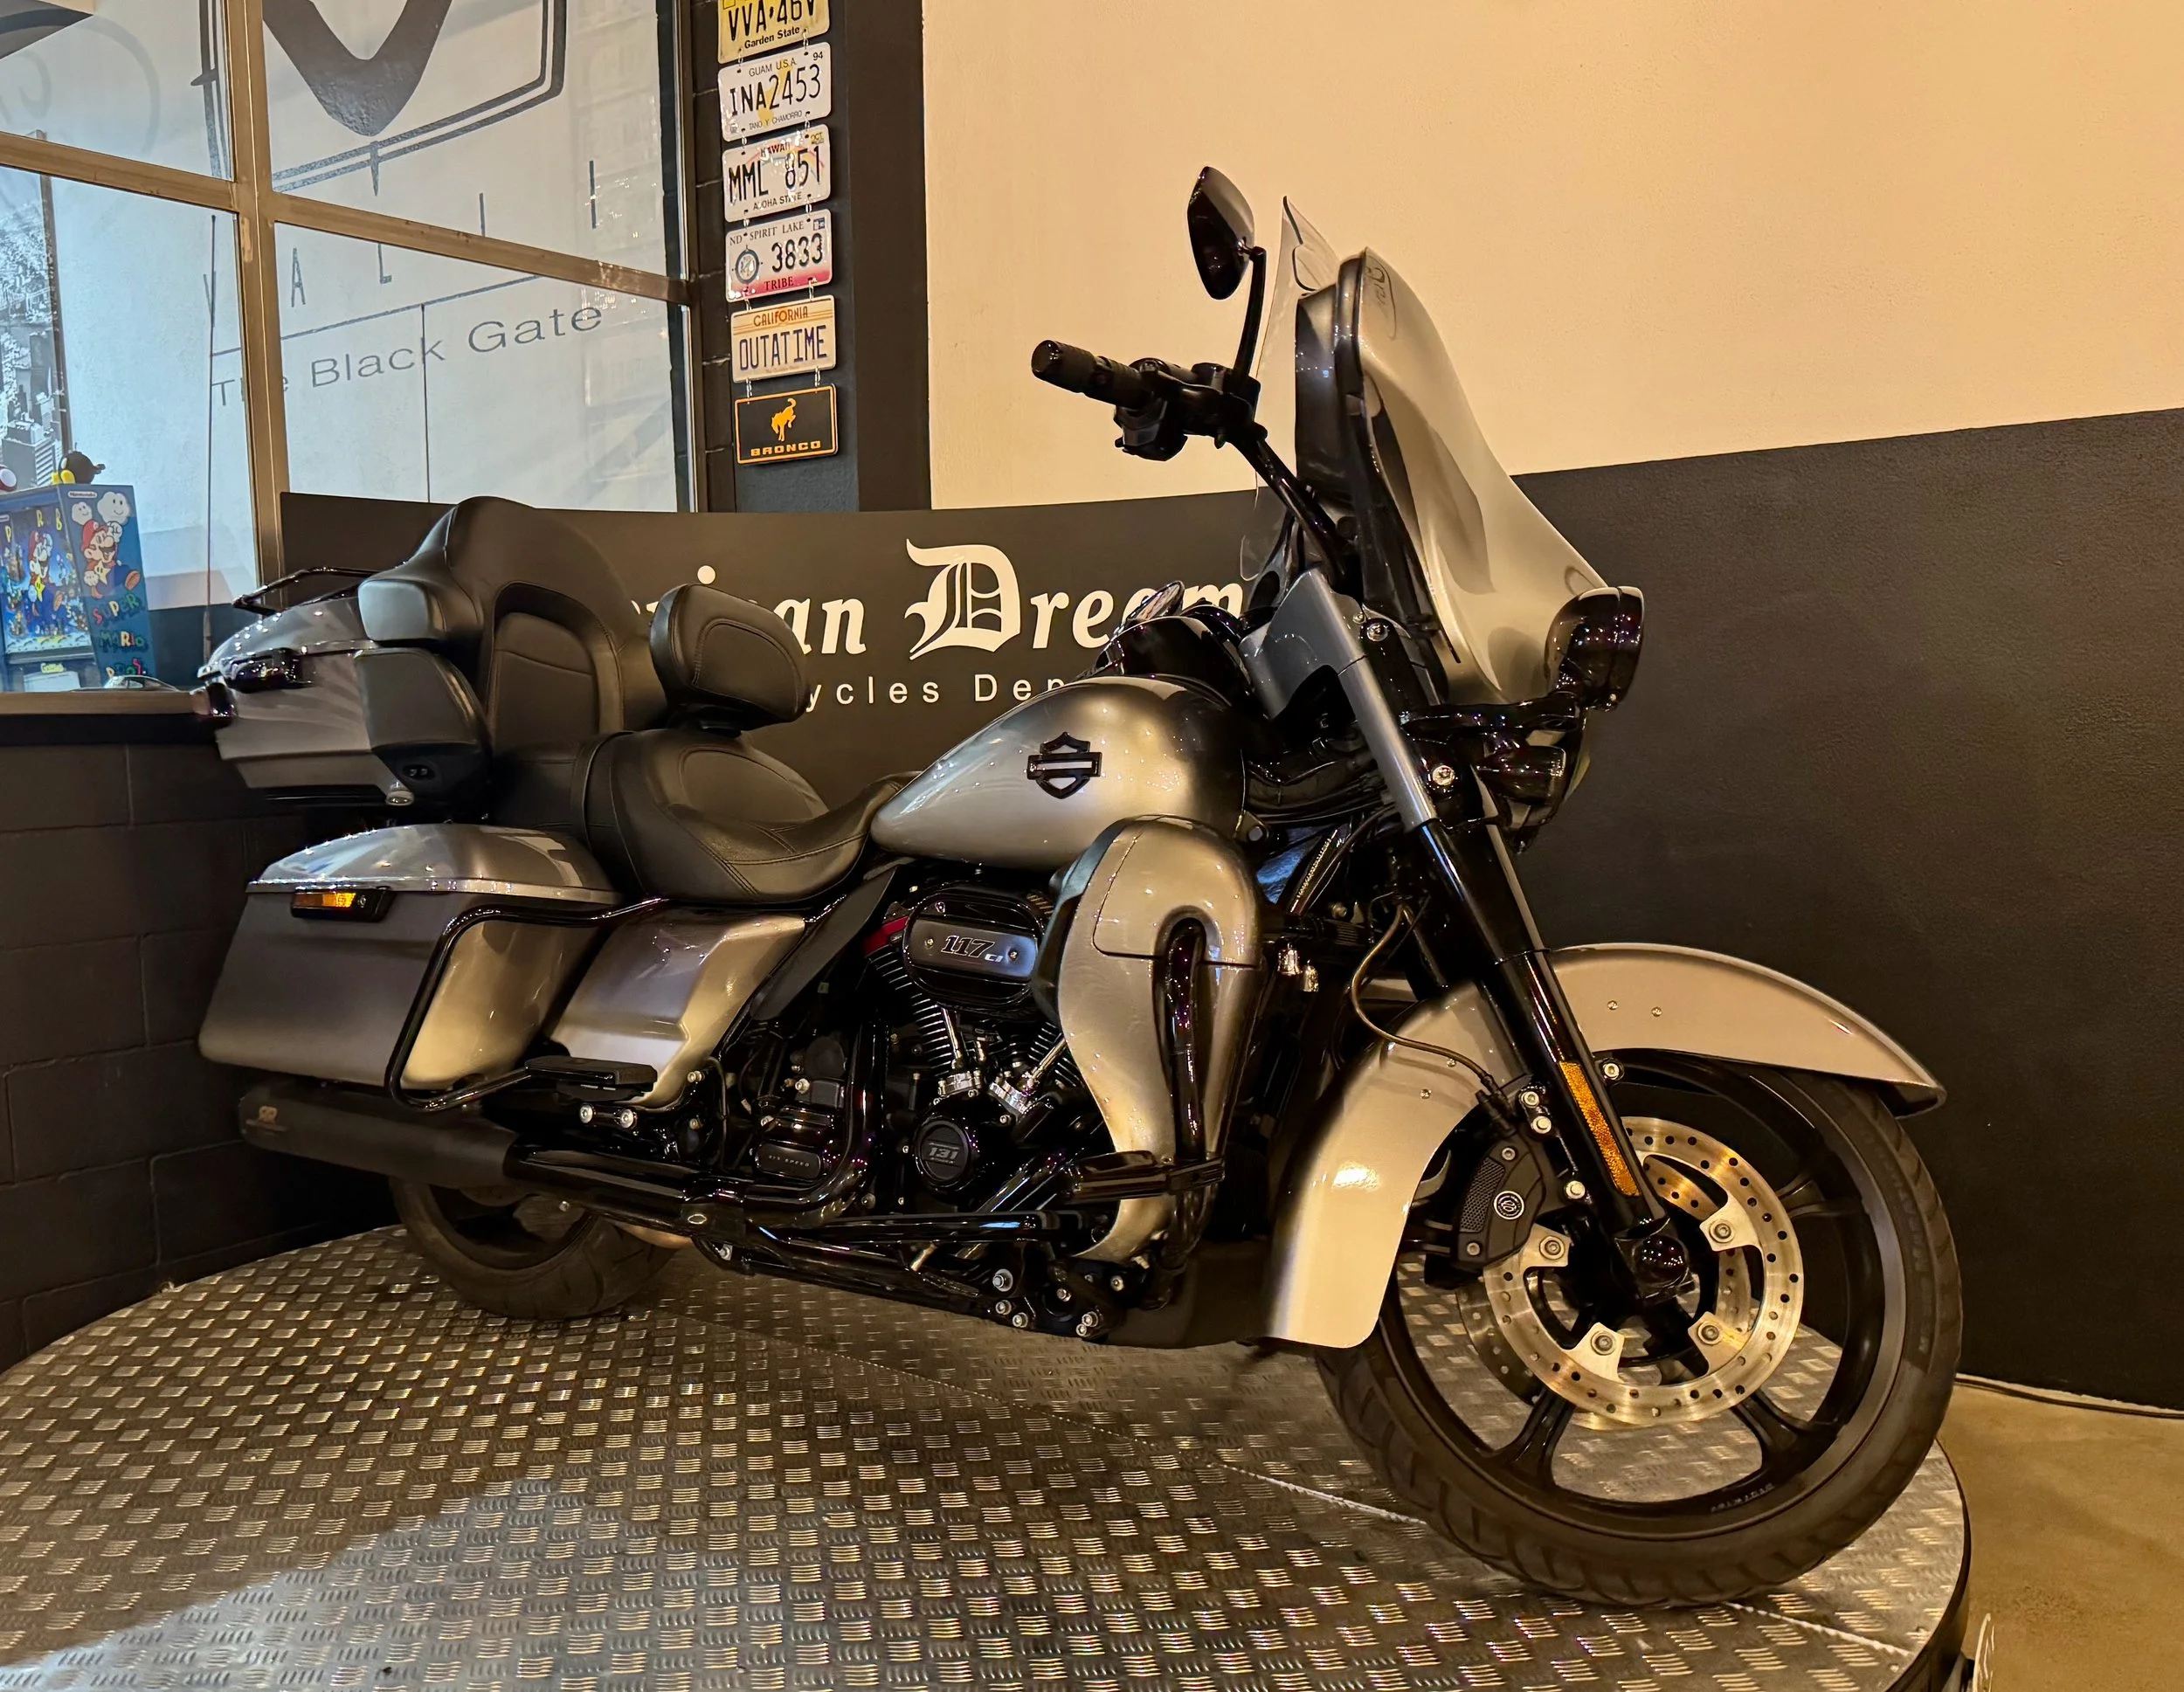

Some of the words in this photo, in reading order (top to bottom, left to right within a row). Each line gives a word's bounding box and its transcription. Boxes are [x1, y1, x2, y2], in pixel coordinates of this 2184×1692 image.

[744, 33, 775, 49] Garden
[777, 26, 800, 39] State
[749, 63, 772, 77] GUAM
[812, 51, 824, 61] 94
[729, 63, 821, 116] INA2453
[728, 160, 769, 204] MML
[784, 145, 820, 190] 851
[752, 198, 778, 211] AOHA
[779, 191, 803, 204] STE
[729, 234, 743, 246] ND
[749, 226, 778, 241] SPIRIT
[782, 220, 805, 234] LAKE
[771, 232, 823, 273] 3833
[764, 276, 795, 291] TRIBE
[753, 306, 809, 328] CALIFORNIA
[311, 337, 446, 389] Black
[468, 306, 603, 353] Gate
[739, 324, 827, 370] OUTATIME
[750, 440, 821, 457] BRONCO
[941, 935, 997, 958] 117
[928, 1146, 959, 1161] 131
